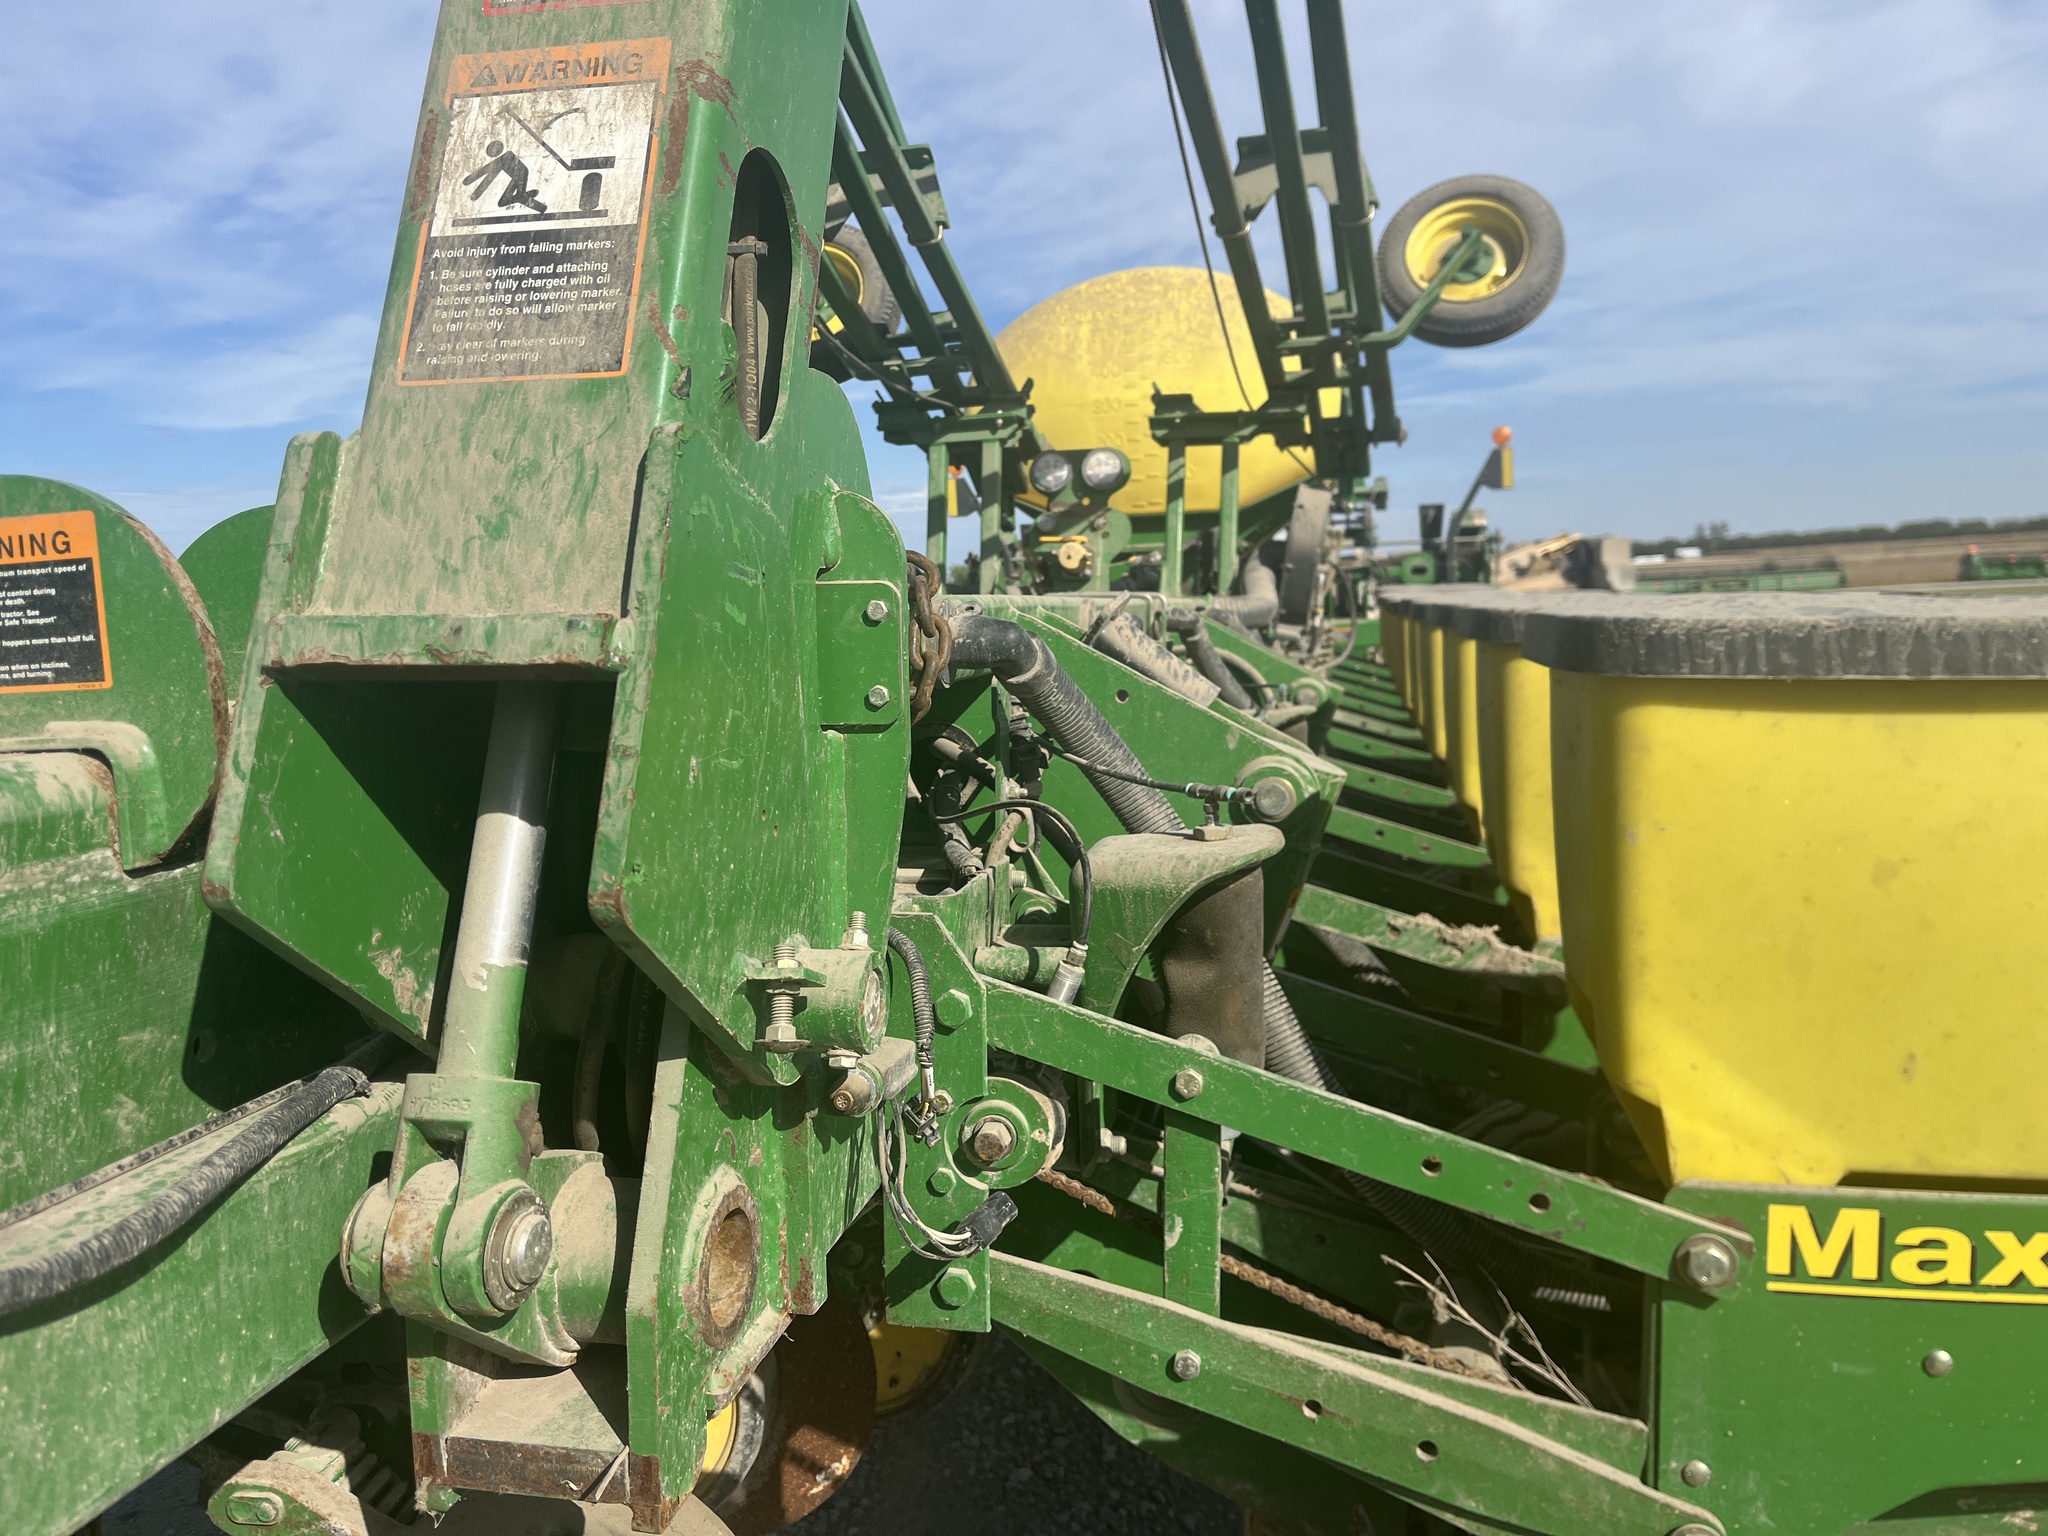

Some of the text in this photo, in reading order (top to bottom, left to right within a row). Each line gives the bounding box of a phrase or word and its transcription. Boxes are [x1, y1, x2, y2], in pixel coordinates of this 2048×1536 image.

[504, 52, 643, 85] WARNING
[432, 239, 615, 259] Avoid injury from falling markers:
[429, 261, 609, 280] 1. Be sure cylinder and attaching
[439, 282, 471, 293] hoses
[494, 278, 519, 291] fully
[521, 276, 568, 289] charged
[570, 274, 594, 285] with
[596, 273, 611, 283] oil
[437, 287, 623, 306] before raising or lowering marker.
[488, 306, 503, 316] do
[505, 306, 520, 315] so
[522, 303, 541, 314] will
[543, 303, 573, 314] allow
[577, 301, 616, 312] marker
[432, 319, 506, 333] to fall rapdly.
[415, 343, 426, 353] 2.
[548, 334, 586, 347] during
[426, 354, 464, 366] raising
[17, 567, 52, 576] transport
[54, 565, 77, 574] speed
[78, 563, 87, 571] of
[7, 588, 32, 597] control
[33, 587, 56, 596] during
[0, 609, 40, 618] tractor. See
[4, 619, 20, 627] Safe
[2, 634, 96, 647] hoppers more than half full.
[10, 663, 29, 671] when
[41, 661, 71, 669] inclines,
[12, 671, 26, 679] and
[26, 670, 55, 679] turning.
[1766, 1203, 2048, 1288] Max
